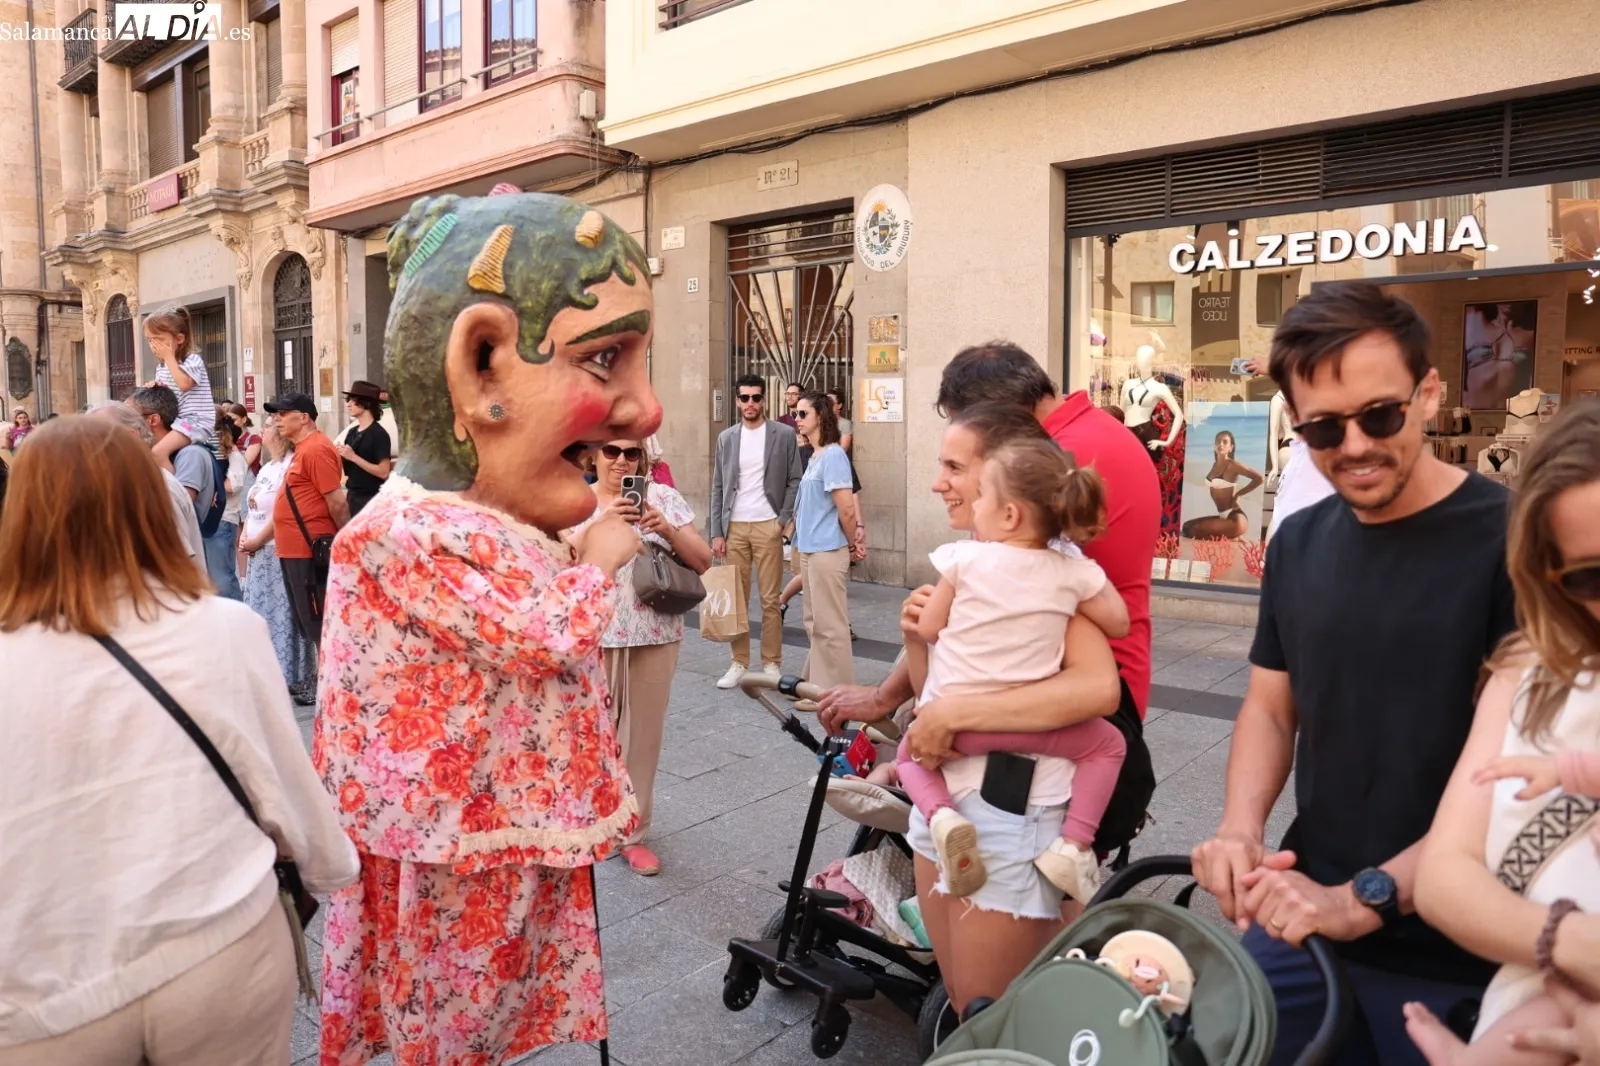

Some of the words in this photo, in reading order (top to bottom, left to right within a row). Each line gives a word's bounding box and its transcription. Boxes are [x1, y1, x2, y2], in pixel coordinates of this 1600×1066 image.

[780, 167, 791, 181] 21
[150, 183, 176, 204] NOTARIA
[880, 259, 895, 269] DEL
[896, 219, 911, 258] URUGUAY
[1168, 214, 1488, 275] CALZEDONIA
[688, 279, 697, 291] 25
[1564, 346, 1593, 355] ITTING
